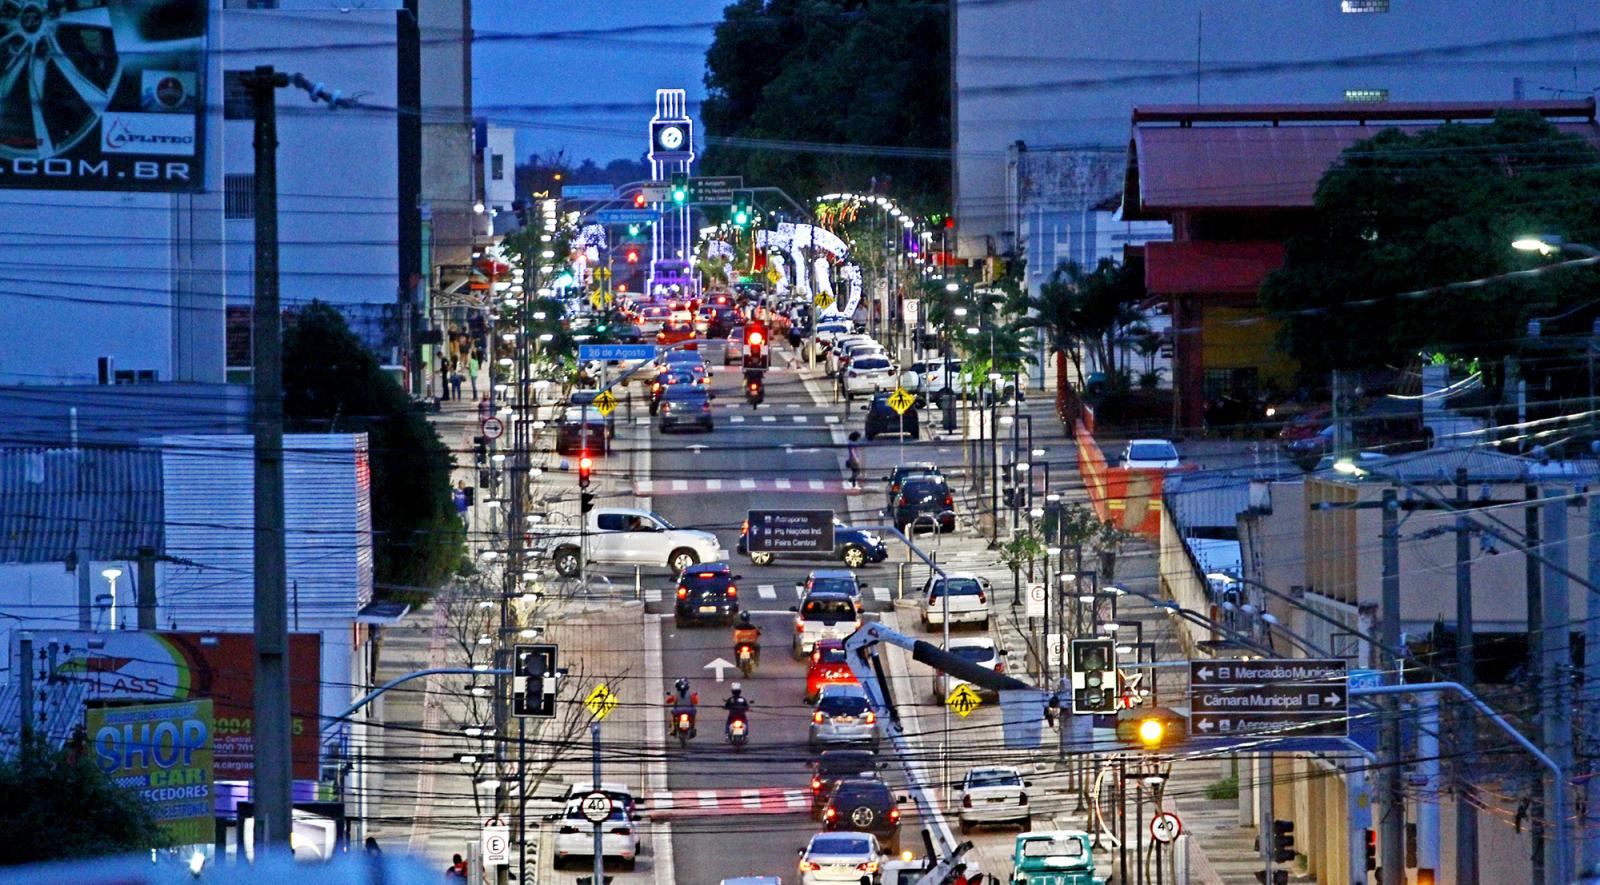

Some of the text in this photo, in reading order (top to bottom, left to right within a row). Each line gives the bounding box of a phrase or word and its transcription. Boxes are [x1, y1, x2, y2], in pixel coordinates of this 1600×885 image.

[1235, 667, 1292, 679] Mercadão
[1203, 694, 1302, 707] Câmara Municipal
[95, 718, 208, 774] SHOP
[588, 799, 604, 810] 40
[492, 839, 500, 851] E
